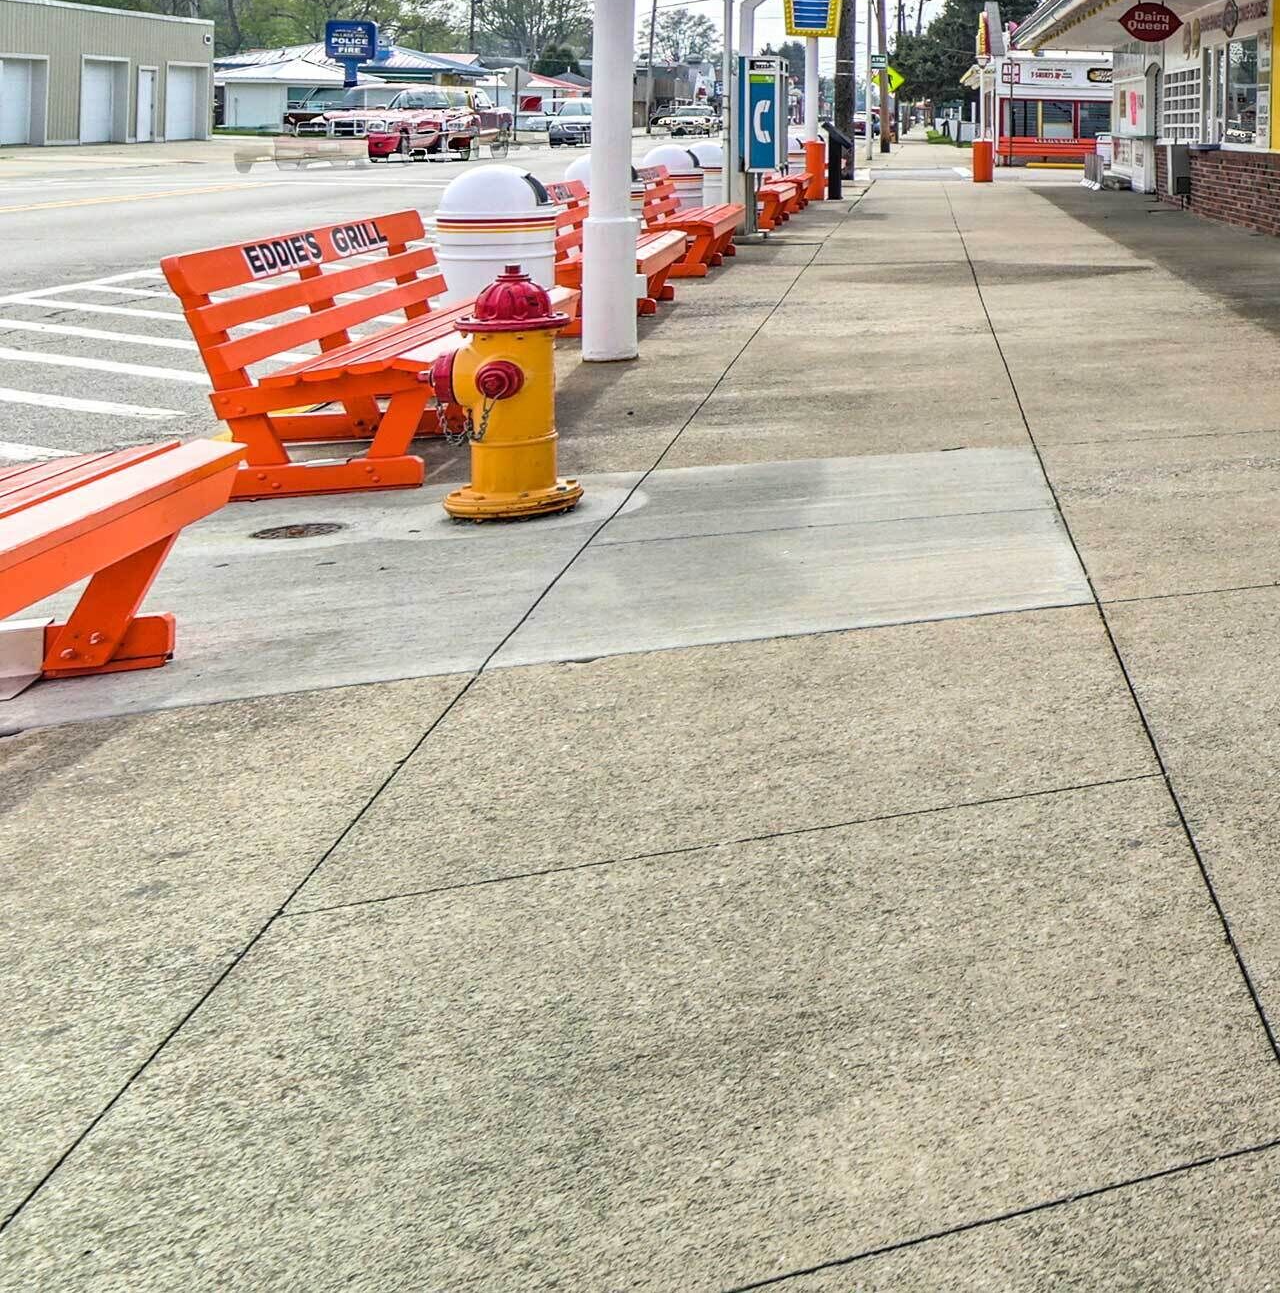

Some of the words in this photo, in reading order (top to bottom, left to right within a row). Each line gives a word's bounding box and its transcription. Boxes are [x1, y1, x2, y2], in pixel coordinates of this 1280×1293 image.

[1135, 11, 1170, 23] Dairy
[1128, 20, 1169, 31] Queen
[331, 37, 369, 45] POLICE
[243, 232, 323, 274] EDDIE'S
[331, 220, 389, 254] GRILL
